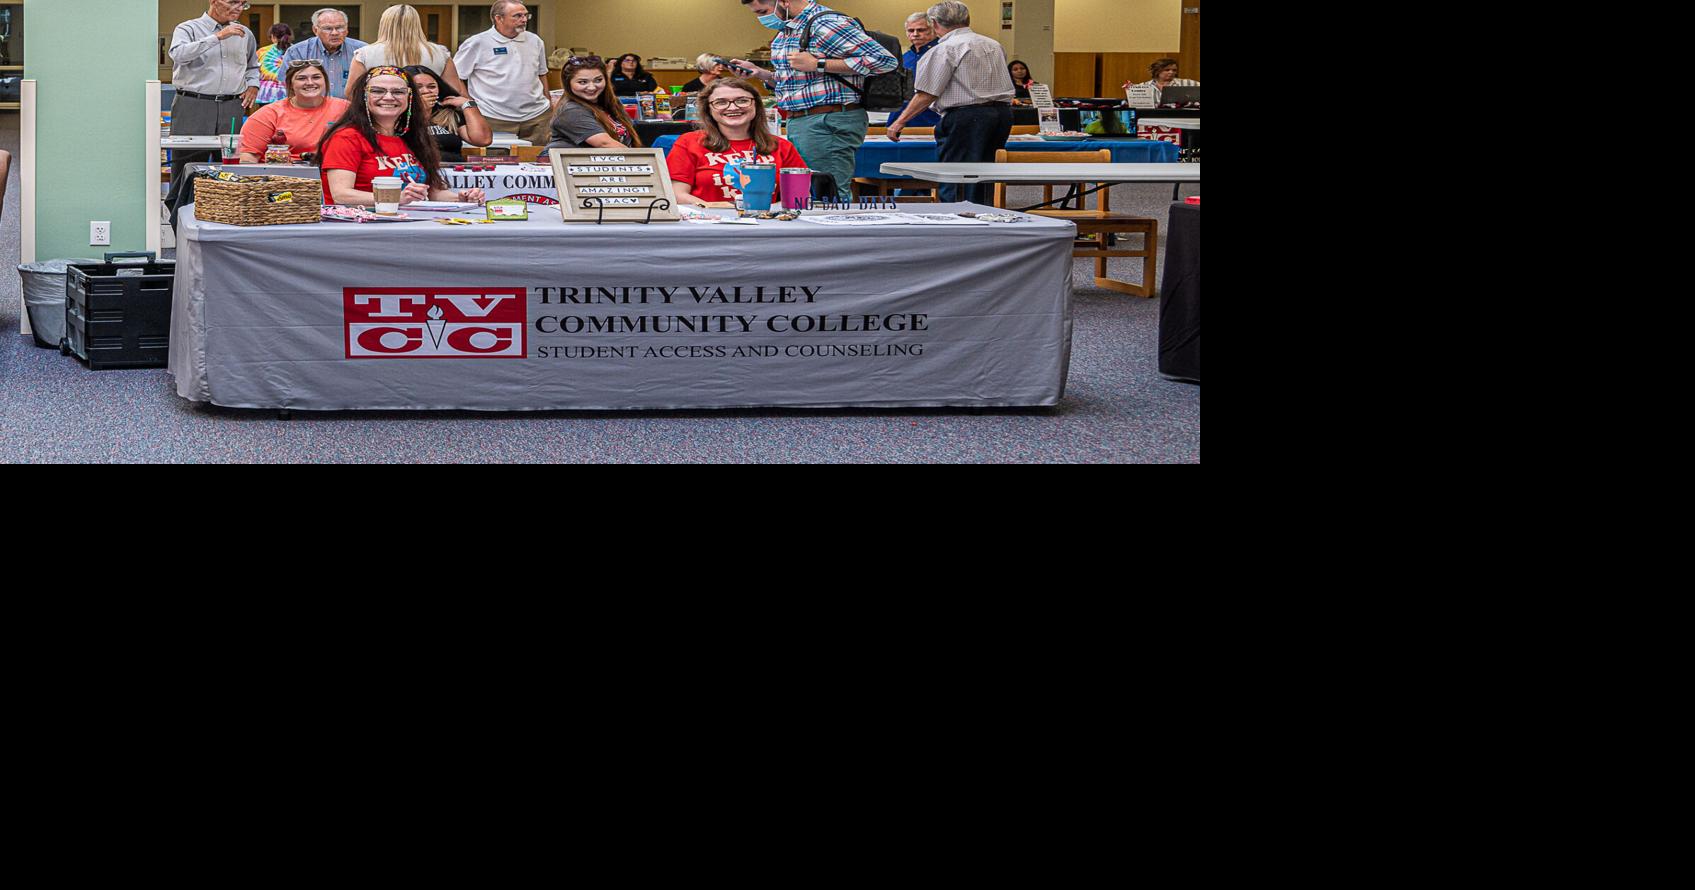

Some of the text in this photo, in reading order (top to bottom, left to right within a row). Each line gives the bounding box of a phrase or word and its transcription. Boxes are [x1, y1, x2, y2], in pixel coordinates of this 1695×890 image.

[705, 150, 775, 166] KEEP
[503, 174, 557, 189] COMM
[713, 173, 735, 187] it
[794, 195, 897, 211] NO BAD DAYS
[535, 286, 823, 304] TRINITY VALLEY
[535, 313, 929, 334] COMMUNITY COLLEGE
[537, 343, 923, 358] STUDENT ACCESS AND COUNSELING
